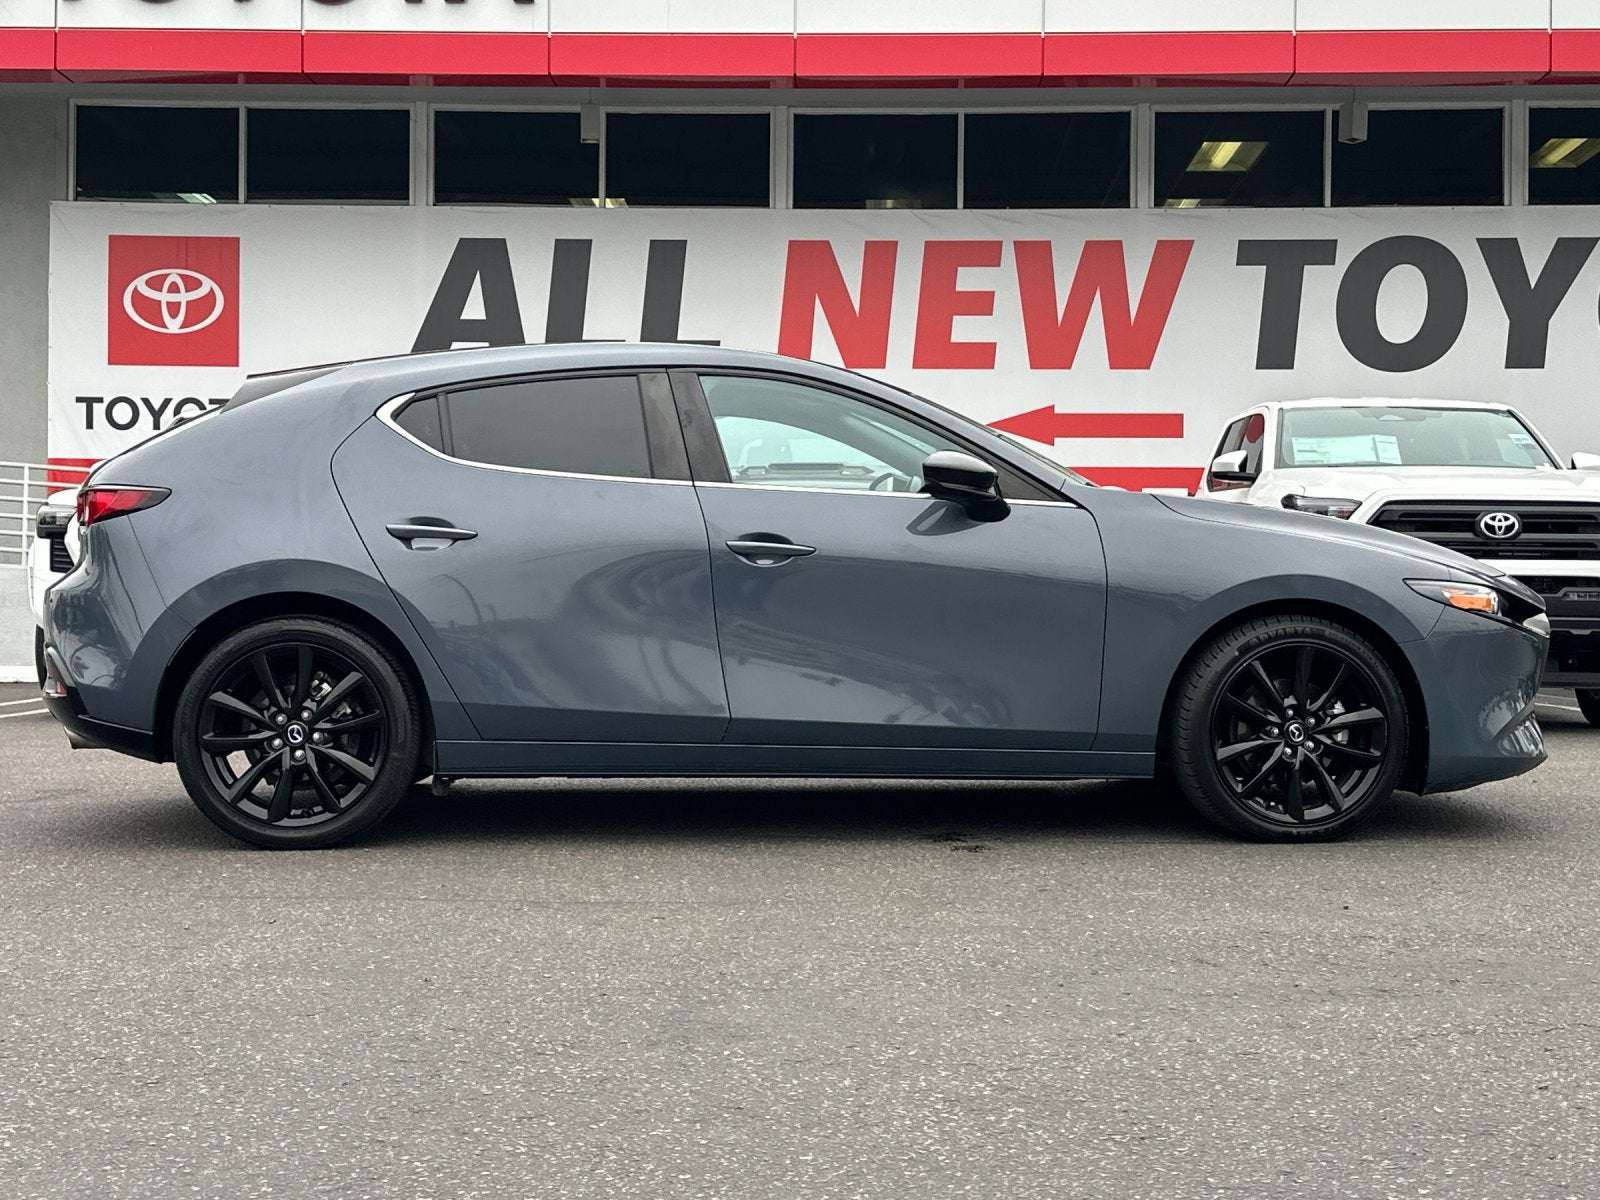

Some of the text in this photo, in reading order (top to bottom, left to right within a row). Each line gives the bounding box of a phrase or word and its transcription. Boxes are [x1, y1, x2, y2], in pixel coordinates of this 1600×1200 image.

[411, 235, 1600, 372] ALL NEW TOY
